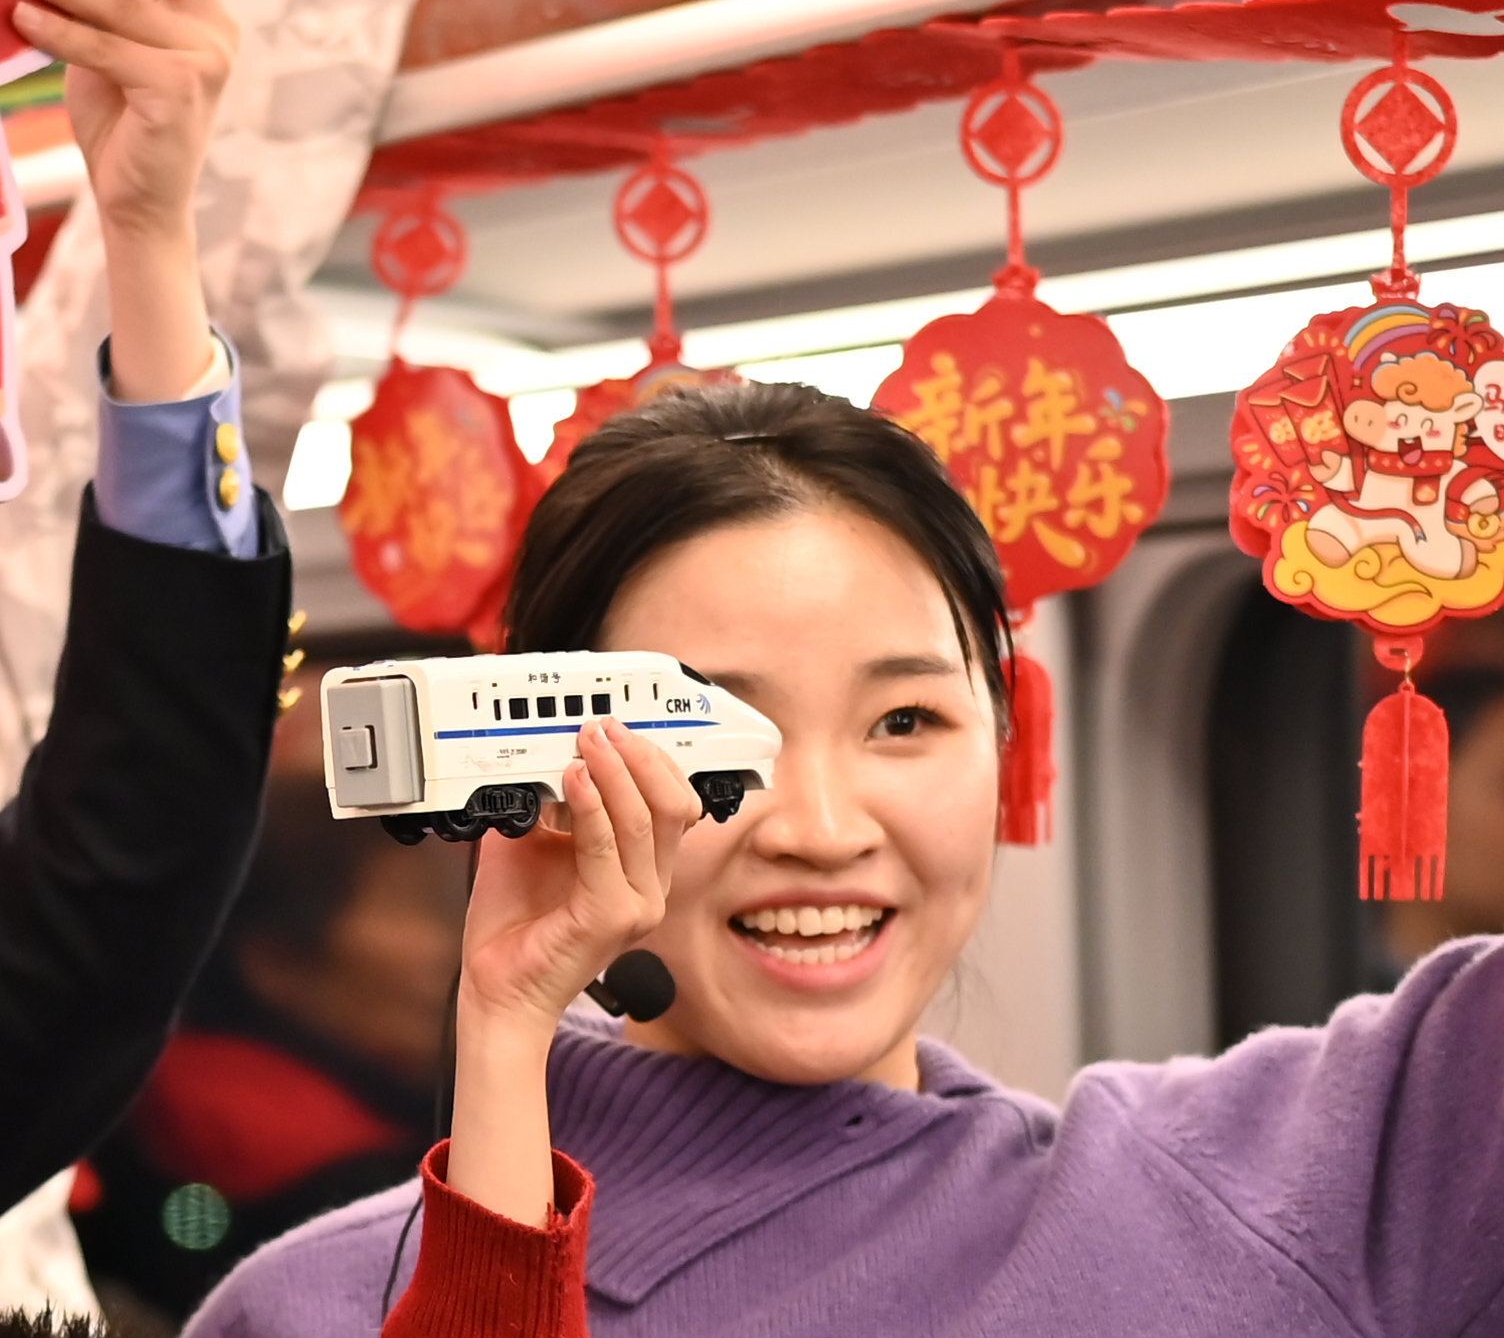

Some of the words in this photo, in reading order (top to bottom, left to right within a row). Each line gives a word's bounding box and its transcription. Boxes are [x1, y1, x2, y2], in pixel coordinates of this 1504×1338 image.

[899, 353, 1097, 471] 新年
[964, 436, 1144, 569] 快乐
[666, 698, 691, 714] CRH
